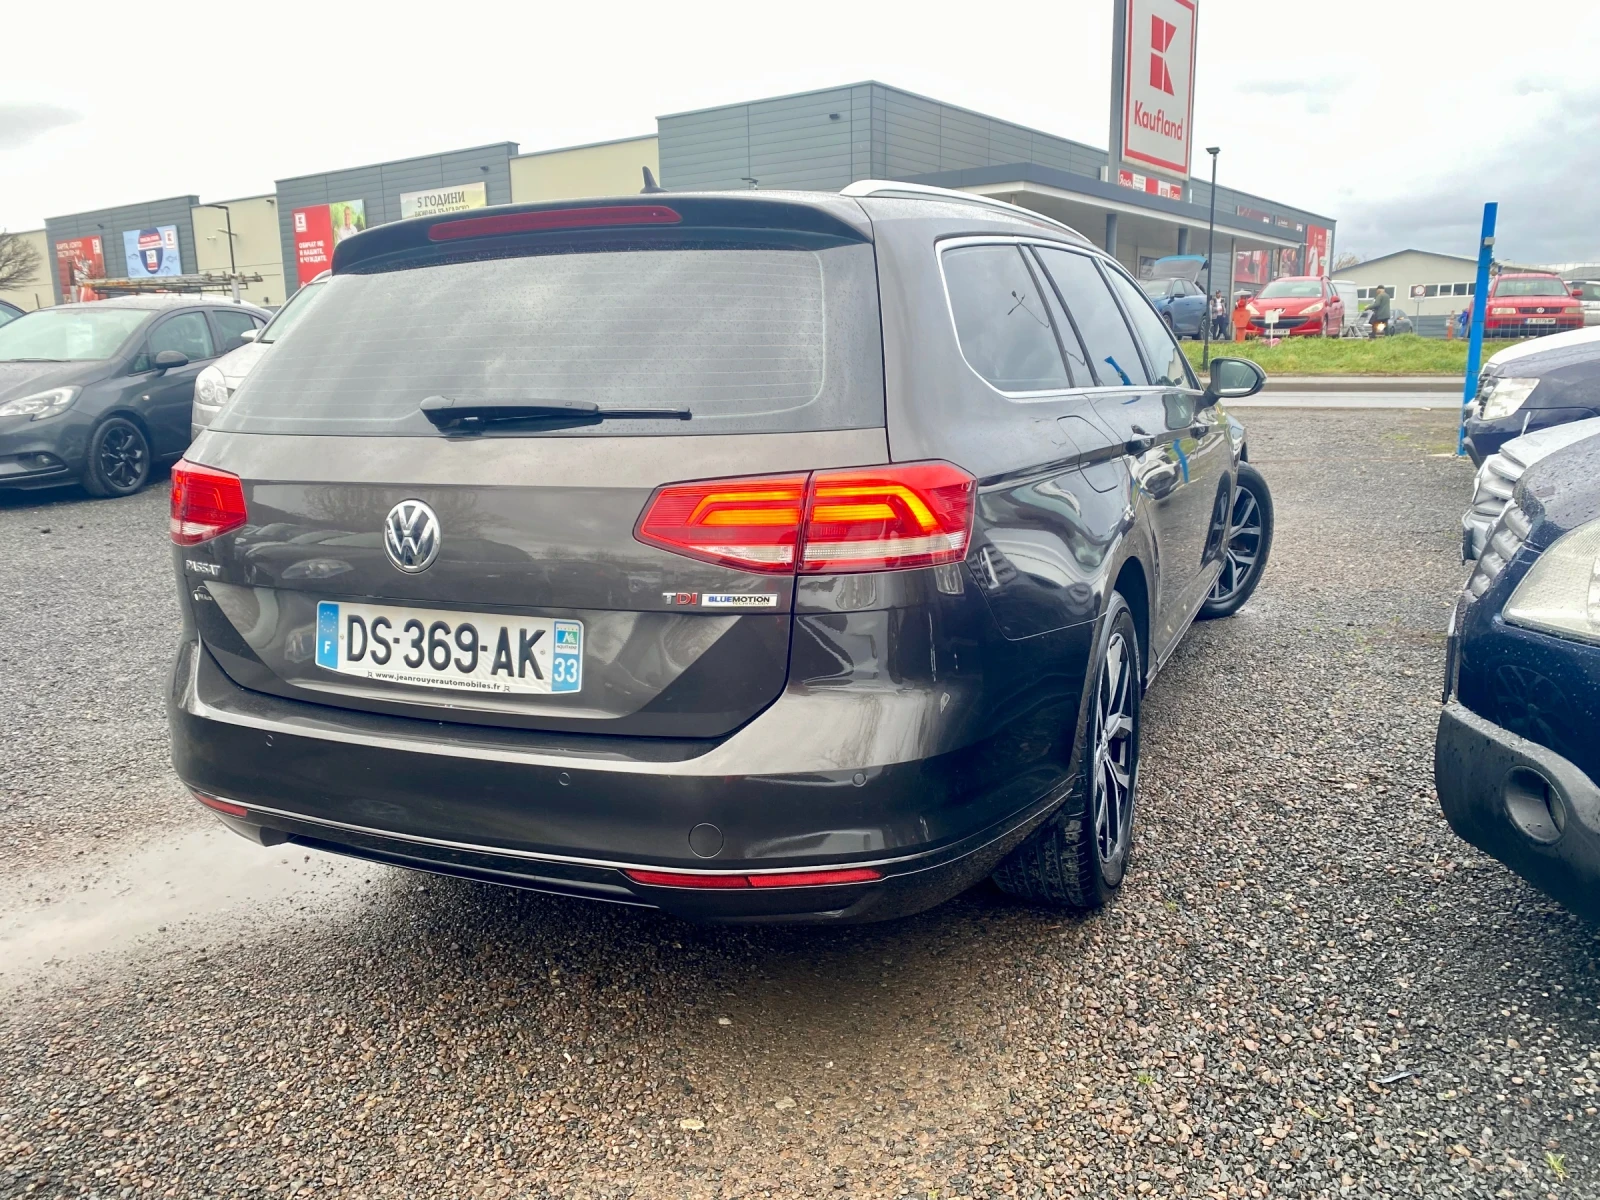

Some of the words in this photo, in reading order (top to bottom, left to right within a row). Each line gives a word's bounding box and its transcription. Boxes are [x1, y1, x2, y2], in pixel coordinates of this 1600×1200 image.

[1134, 100, 1184, 141] Kaufland
[417, 196, 423, 208] 5
[424, 191, 466, 208] ГОДИНИ
[185, 559, 221, 576] PASSAT
[662, 592, 698, 605] TDI
[708, 595, 770, 603] BLUEMOTION
[324, 640, 332, 654] F
[346, 614, 546, 681] DS-369-AK
[554, 657, 578, 683] 33
[375, 671, 501, 690] www.jeanrouyerautomobiles.fr
